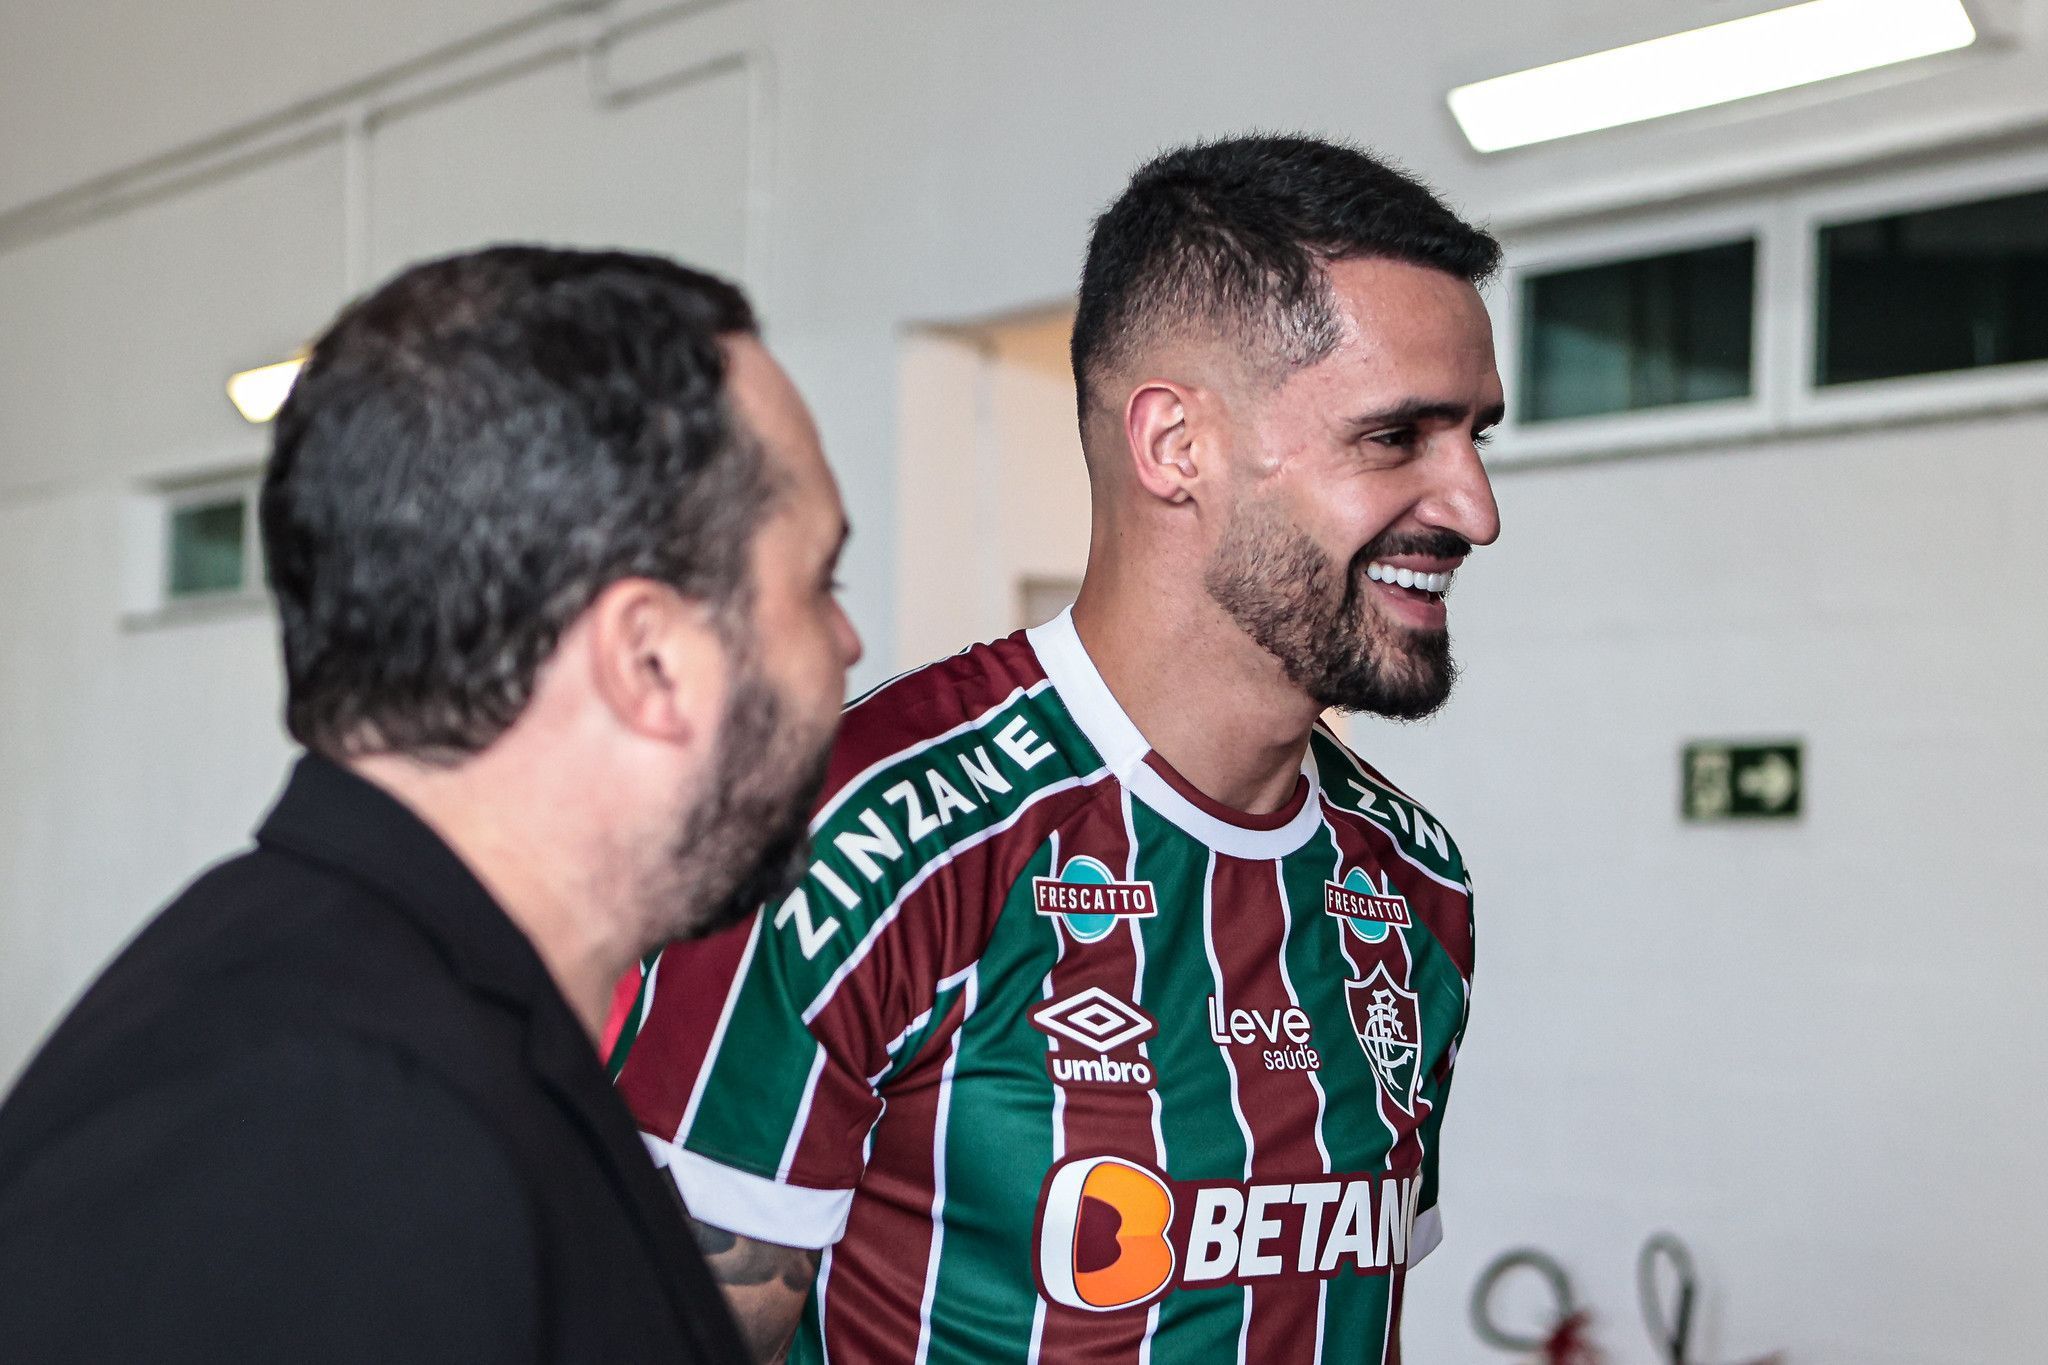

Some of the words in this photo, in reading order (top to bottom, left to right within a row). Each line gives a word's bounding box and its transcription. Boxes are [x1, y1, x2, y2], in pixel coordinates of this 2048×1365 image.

[774, 714, 1056, 961] ZINZANE
[1347, 778, 1473, 893] ZIN
[1038, 885, 1147, 910] FRESCATTO
[1327, 889, 1404, 921] FRESCATTO
[1208, 996, 1311, 1045] Leve
[1052, 1054, 1151, 1084] umbro
[1263, 1044, 1320, 1070] saúde
